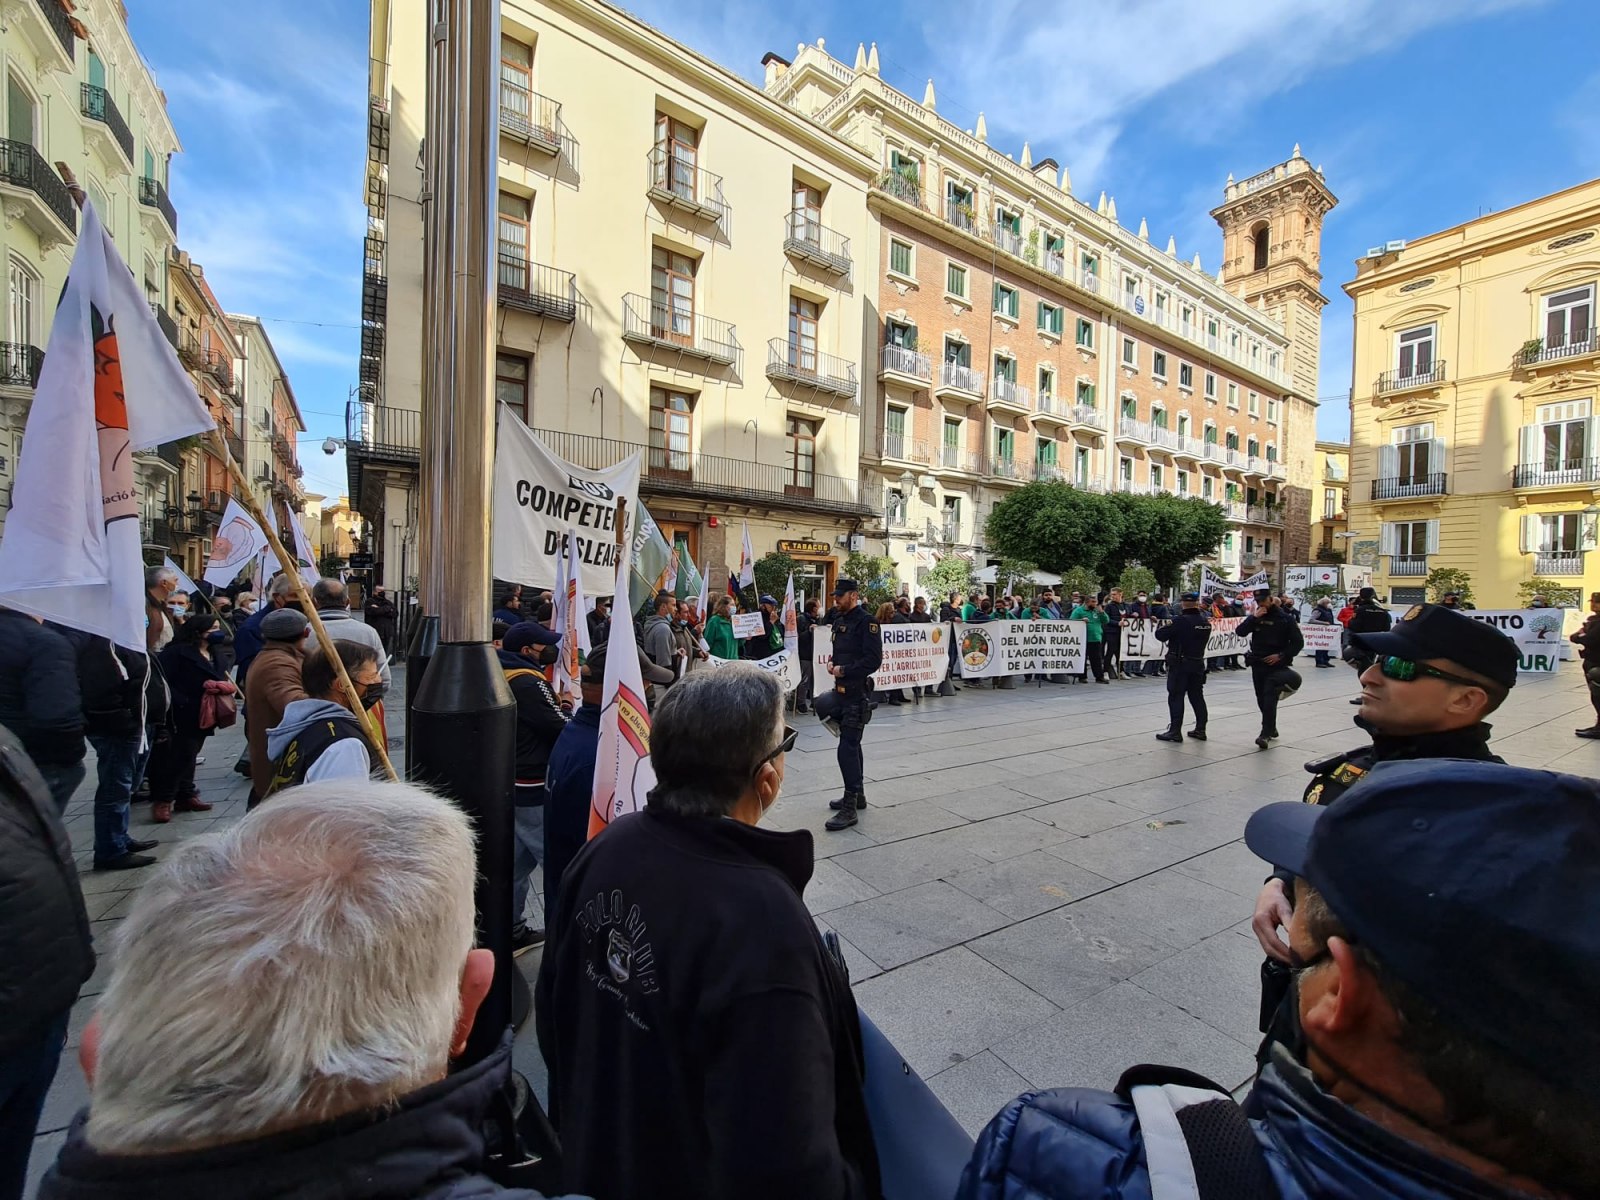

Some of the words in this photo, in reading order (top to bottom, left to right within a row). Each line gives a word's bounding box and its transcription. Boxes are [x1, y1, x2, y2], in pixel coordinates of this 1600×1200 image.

[102, 490, 129, 505] iació
[792, 542, 828, 551] TABACOS
[1011, 624, 1024, 633] EN
[1028, 624, 1071, 633] DEFENSA
[883, 629, 927, 644] RIBERA
[1001, 637, 1019, 646] DEL
[1023, 634, 1047, 646] MÓN
[1050, 636, 1081, 646] RURAL
[1127, 633, 1150, 657] EL
[891, 648, 917, 659] RIBERES
[917, 648, 928, 657] ALTA
[1007, 648, 1081, 658] L'AGRICULTURA
[891, 660, 932, 672] L'AGRICULTURA
[1007, 661, 1020, 671] DE
[1024, 661, 1036, 670] LA
[1041, 660, 1074, 669] RIBERA
[876, 676, 891, 686] PELS
[892, 673, 920, 684] NOSTRES
